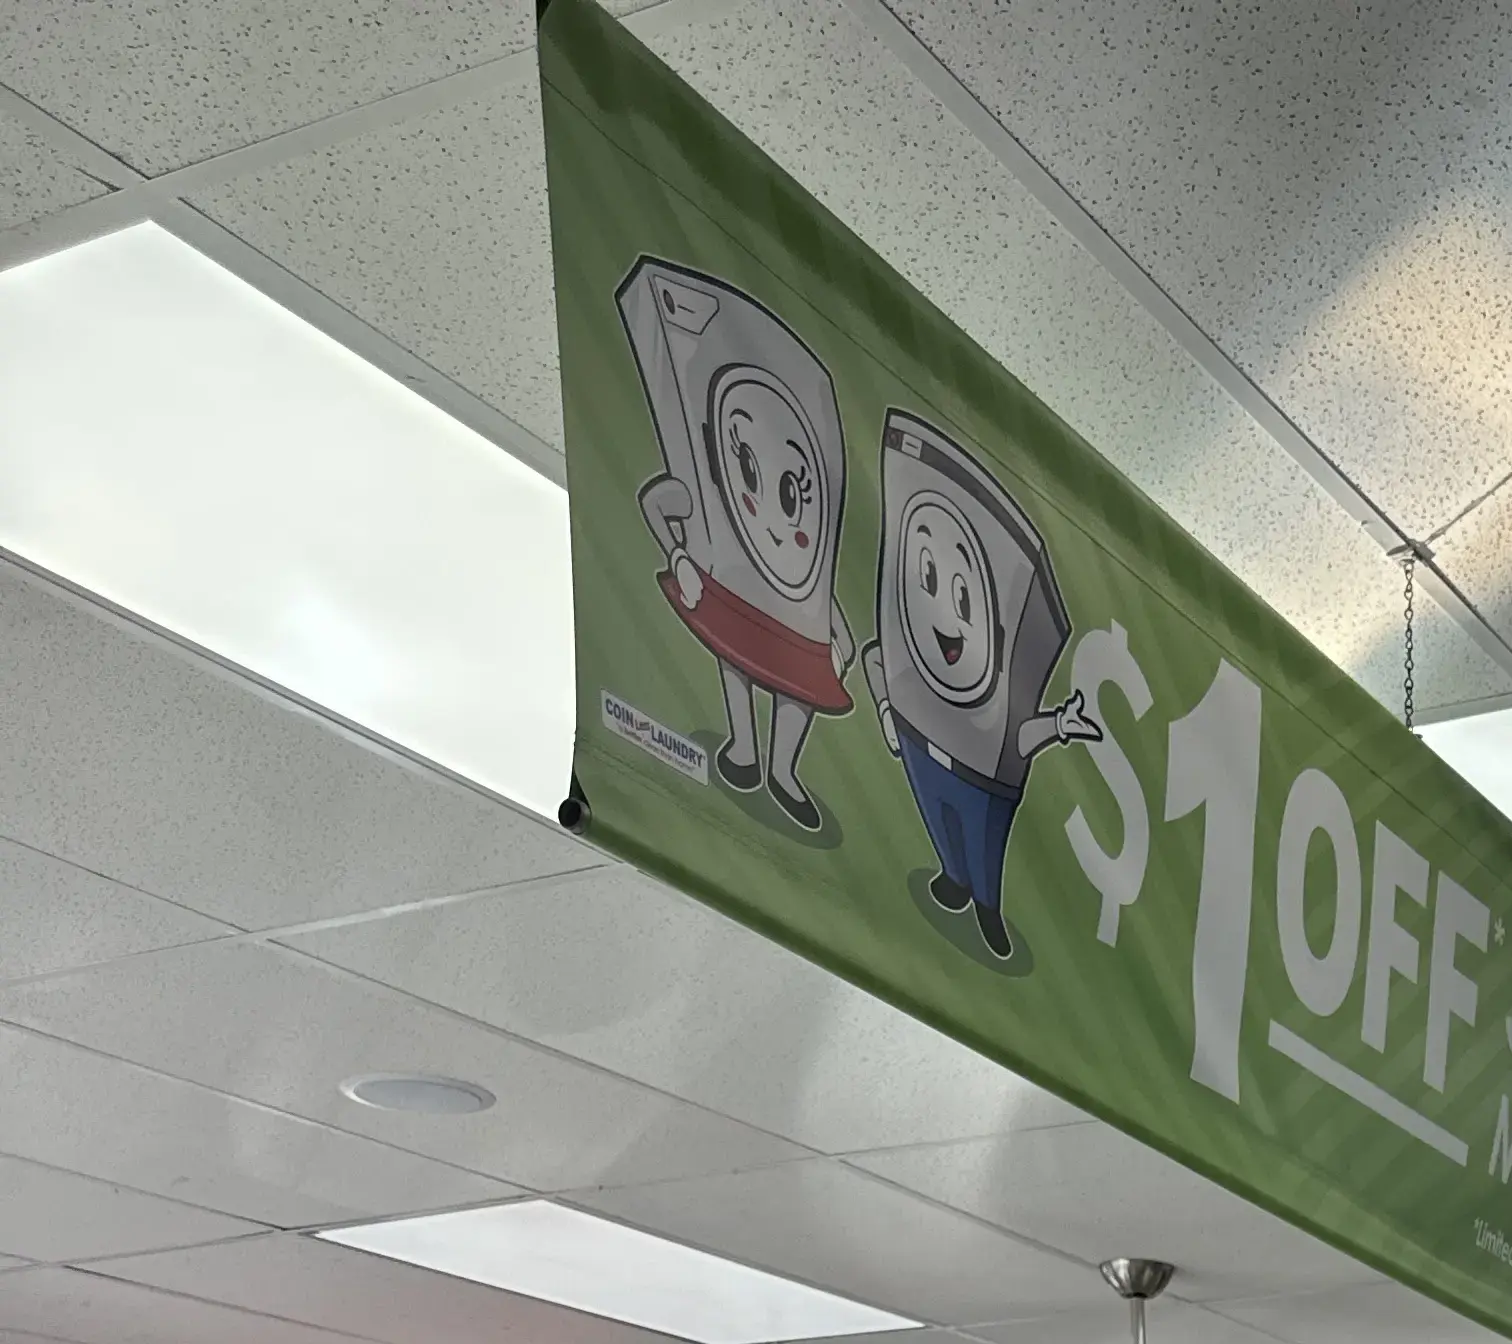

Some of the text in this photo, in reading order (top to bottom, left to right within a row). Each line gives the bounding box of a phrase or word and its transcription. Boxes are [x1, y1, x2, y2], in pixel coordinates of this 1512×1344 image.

[605, 698, 634, 730] COIN
[651, 724, 703, 768] LAUNDRY
[1065, 619, 1261, 1103] $1
